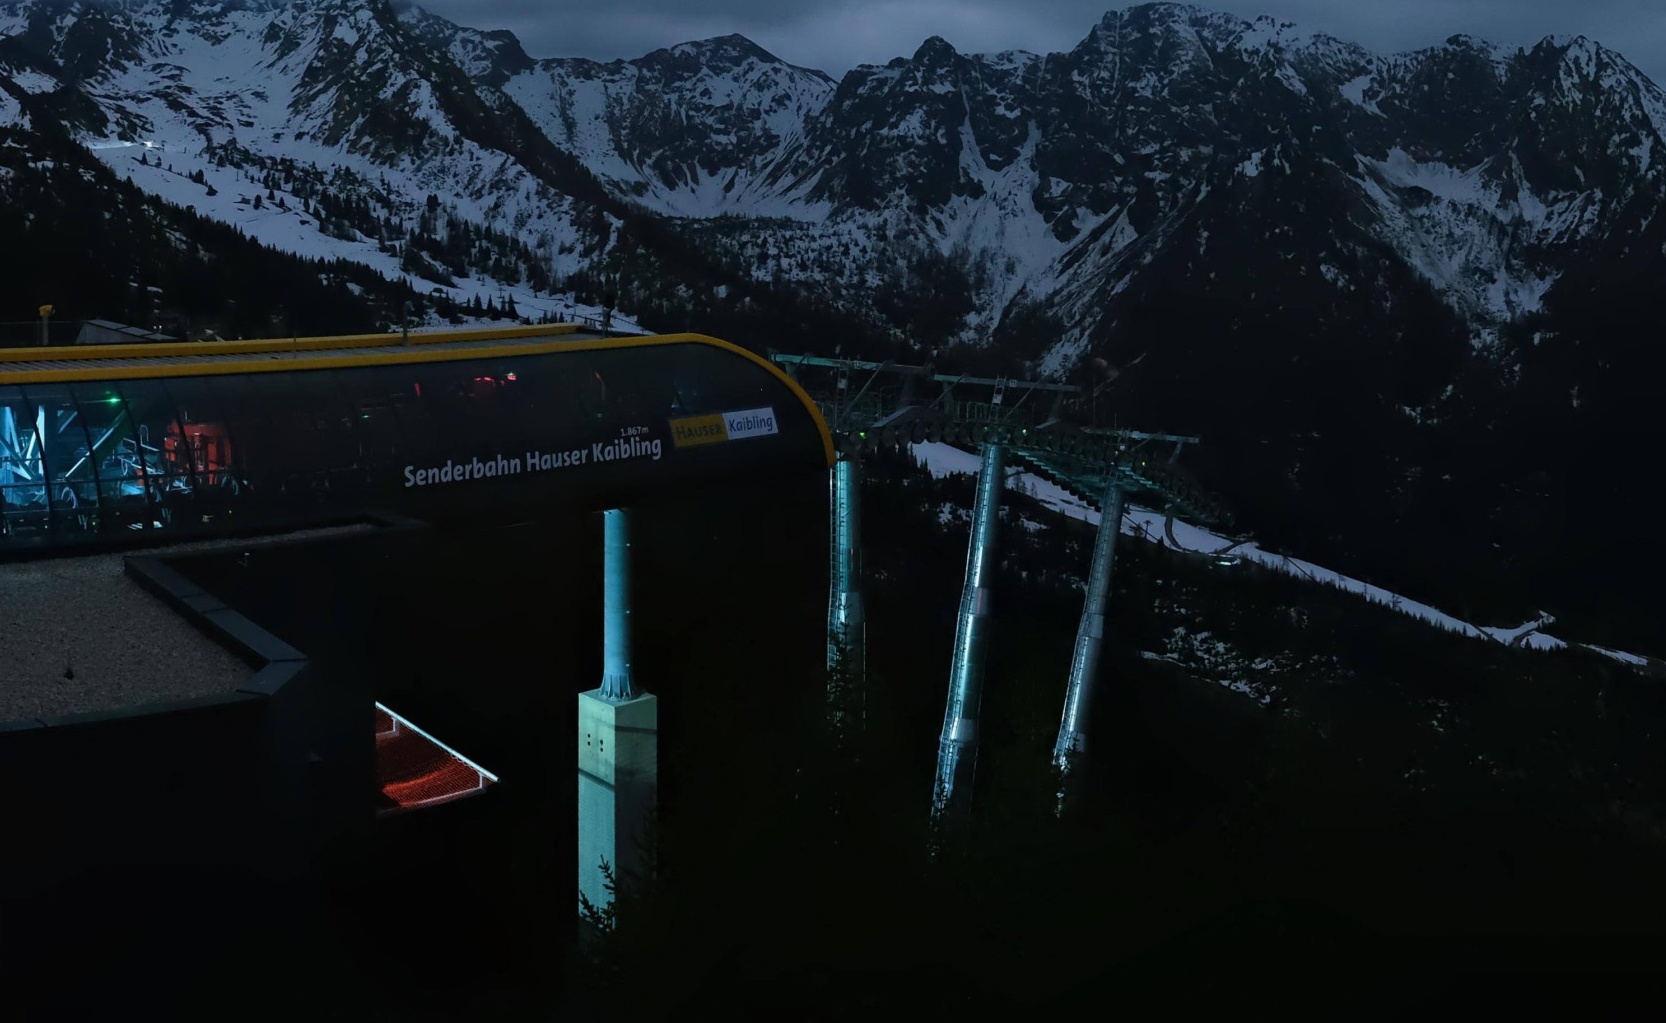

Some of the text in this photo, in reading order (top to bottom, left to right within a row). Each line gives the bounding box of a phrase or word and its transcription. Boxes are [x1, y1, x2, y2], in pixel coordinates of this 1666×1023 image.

[620, 426, 649, 437] 1.867m
[676, 415, 774, 440] HAUSER Kaibling
[404, 434, 662, 488] Senderbahn Hauser Kaibling
